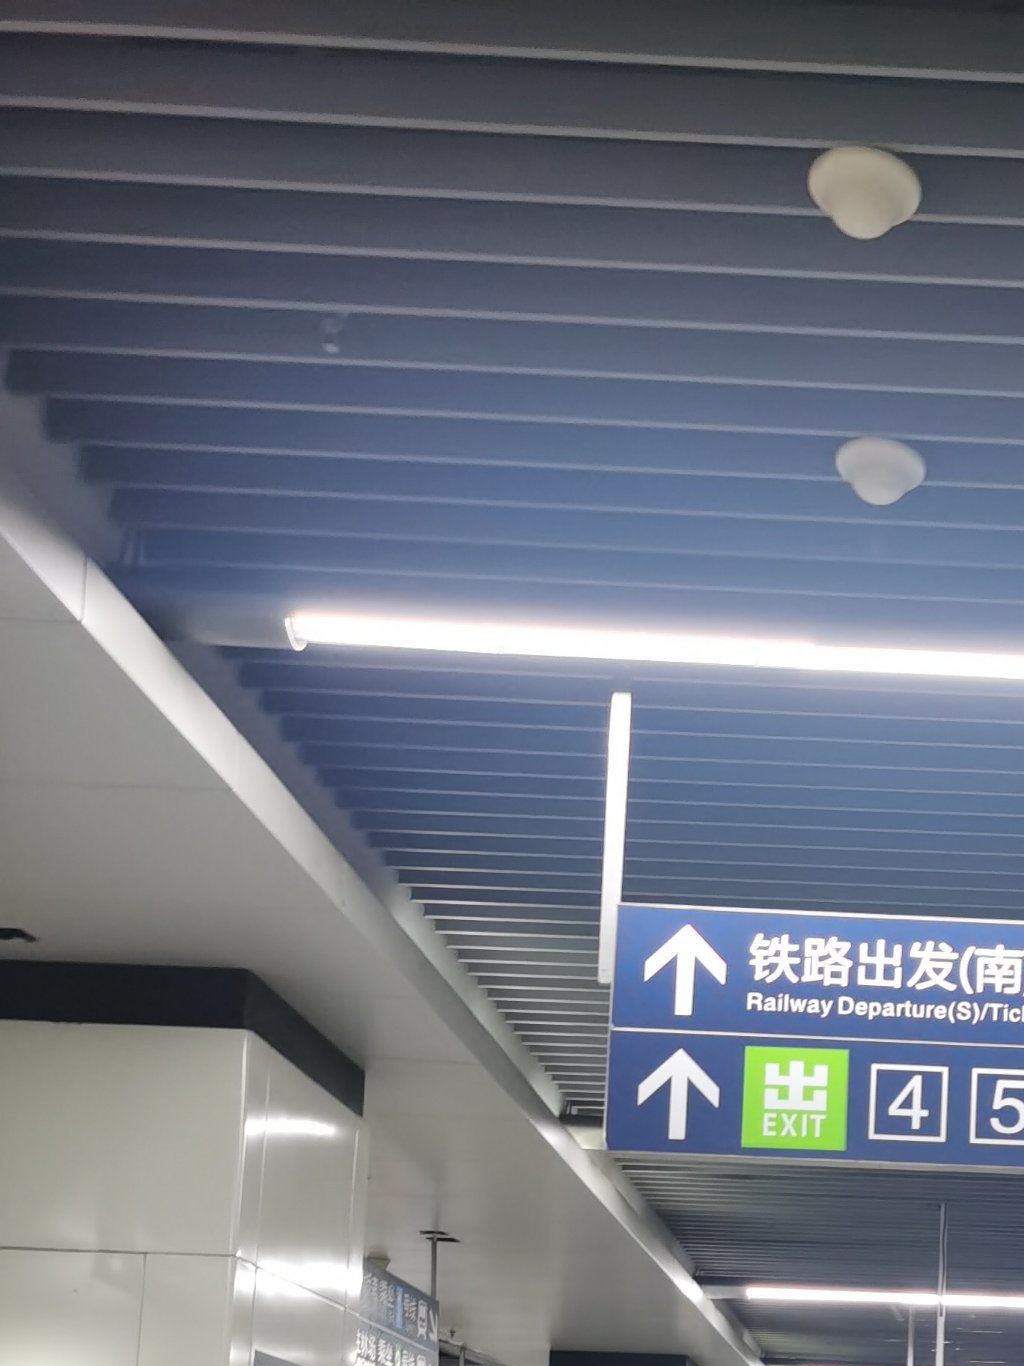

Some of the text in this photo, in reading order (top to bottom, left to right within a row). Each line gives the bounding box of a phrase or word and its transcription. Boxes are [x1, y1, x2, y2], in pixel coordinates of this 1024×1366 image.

[747, 992, 833, 1018] Railway
[764, 1061, 828, 1110] 出
[888, 1074, 929, 1130] 4
[762, 1113, 826, 1138] EXIT
